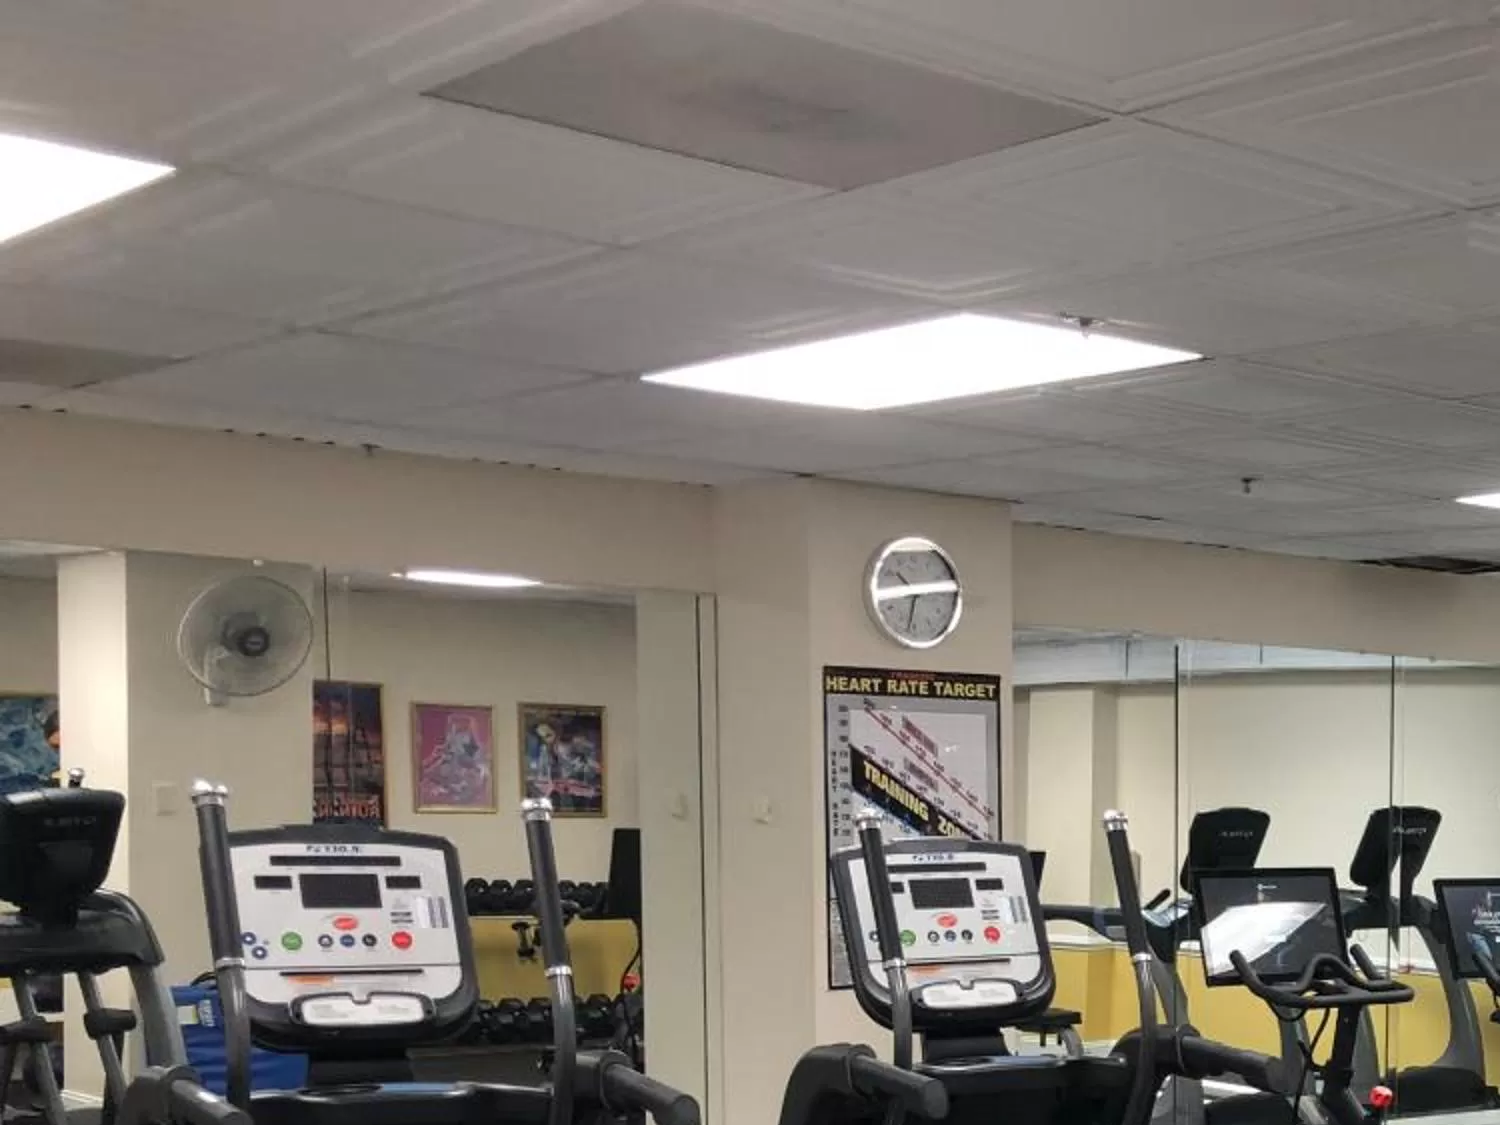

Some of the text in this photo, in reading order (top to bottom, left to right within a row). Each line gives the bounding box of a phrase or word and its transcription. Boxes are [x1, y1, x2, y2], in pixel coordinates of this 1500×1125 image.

[826, 675, 882, 692] HEART
[887, 679, 929, 695] RATE
[933, 681, 996, 698] TARGET
[863, 760, 929, 821] TRAINING
[937, 814, 966, 838] ZO
